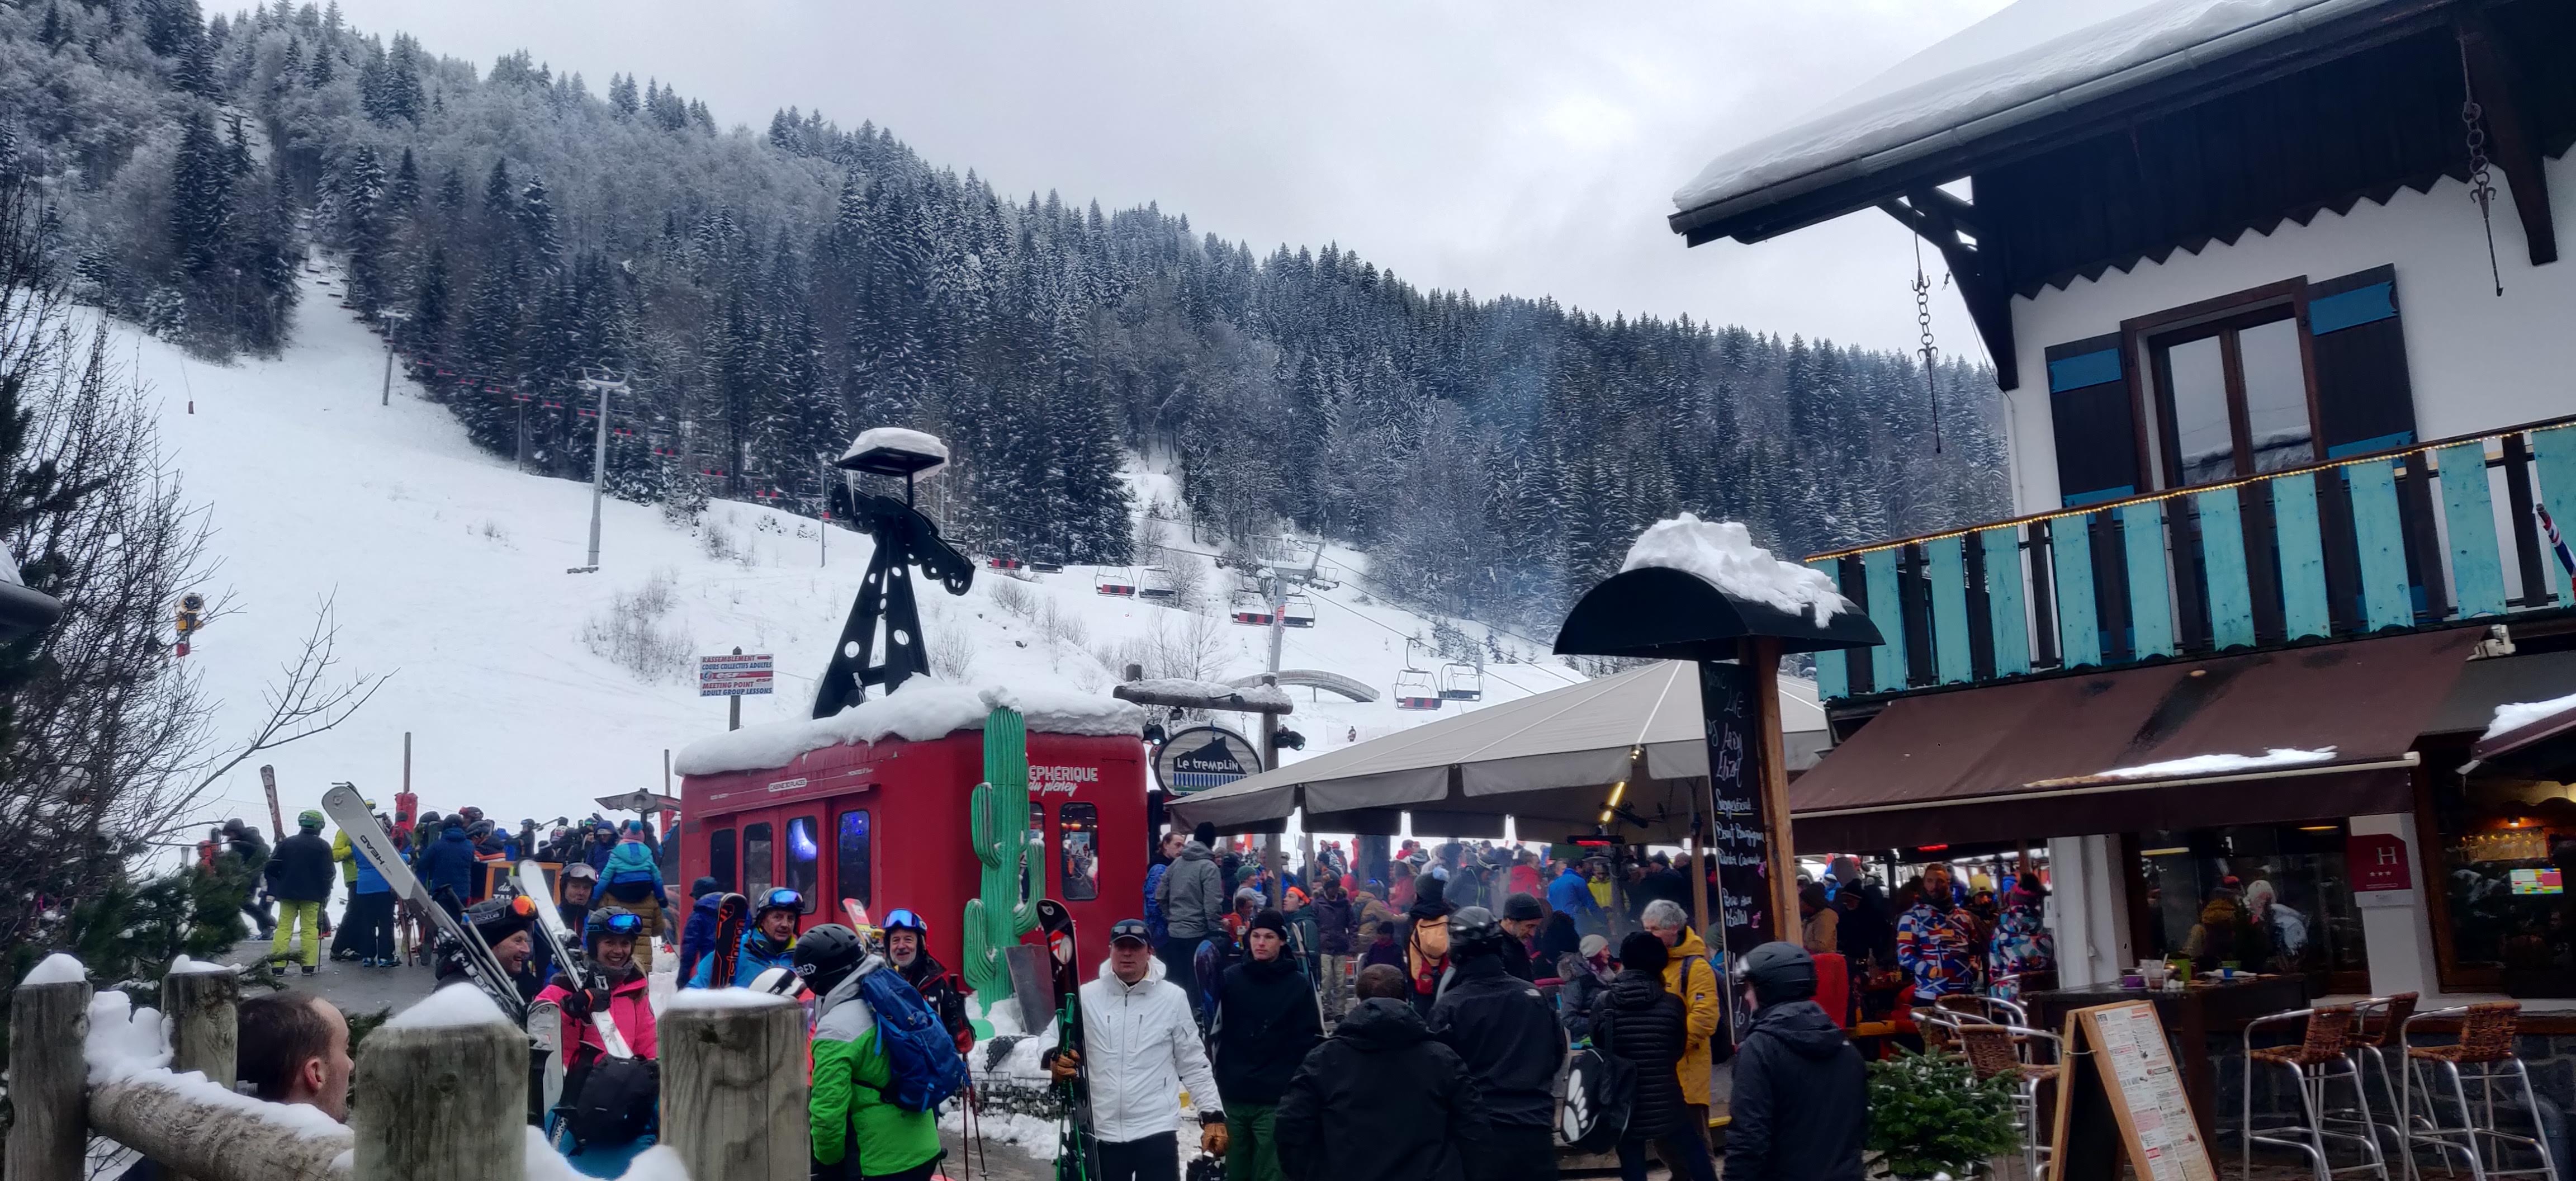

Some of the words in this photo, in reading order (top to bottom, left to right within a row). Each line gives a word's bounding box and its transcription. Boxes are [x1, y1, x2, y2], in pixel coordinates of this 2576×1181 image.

[1177, 757, 1190, 769] Le
[1029, 765, 1098, 782] ÉPHÉRIQUE
[1029, 780, 1043, 792] du
[360, 835, 385, 865] HEAD
[2376, 847, 2398, 865] H
[498, 882, 511, 891] du
